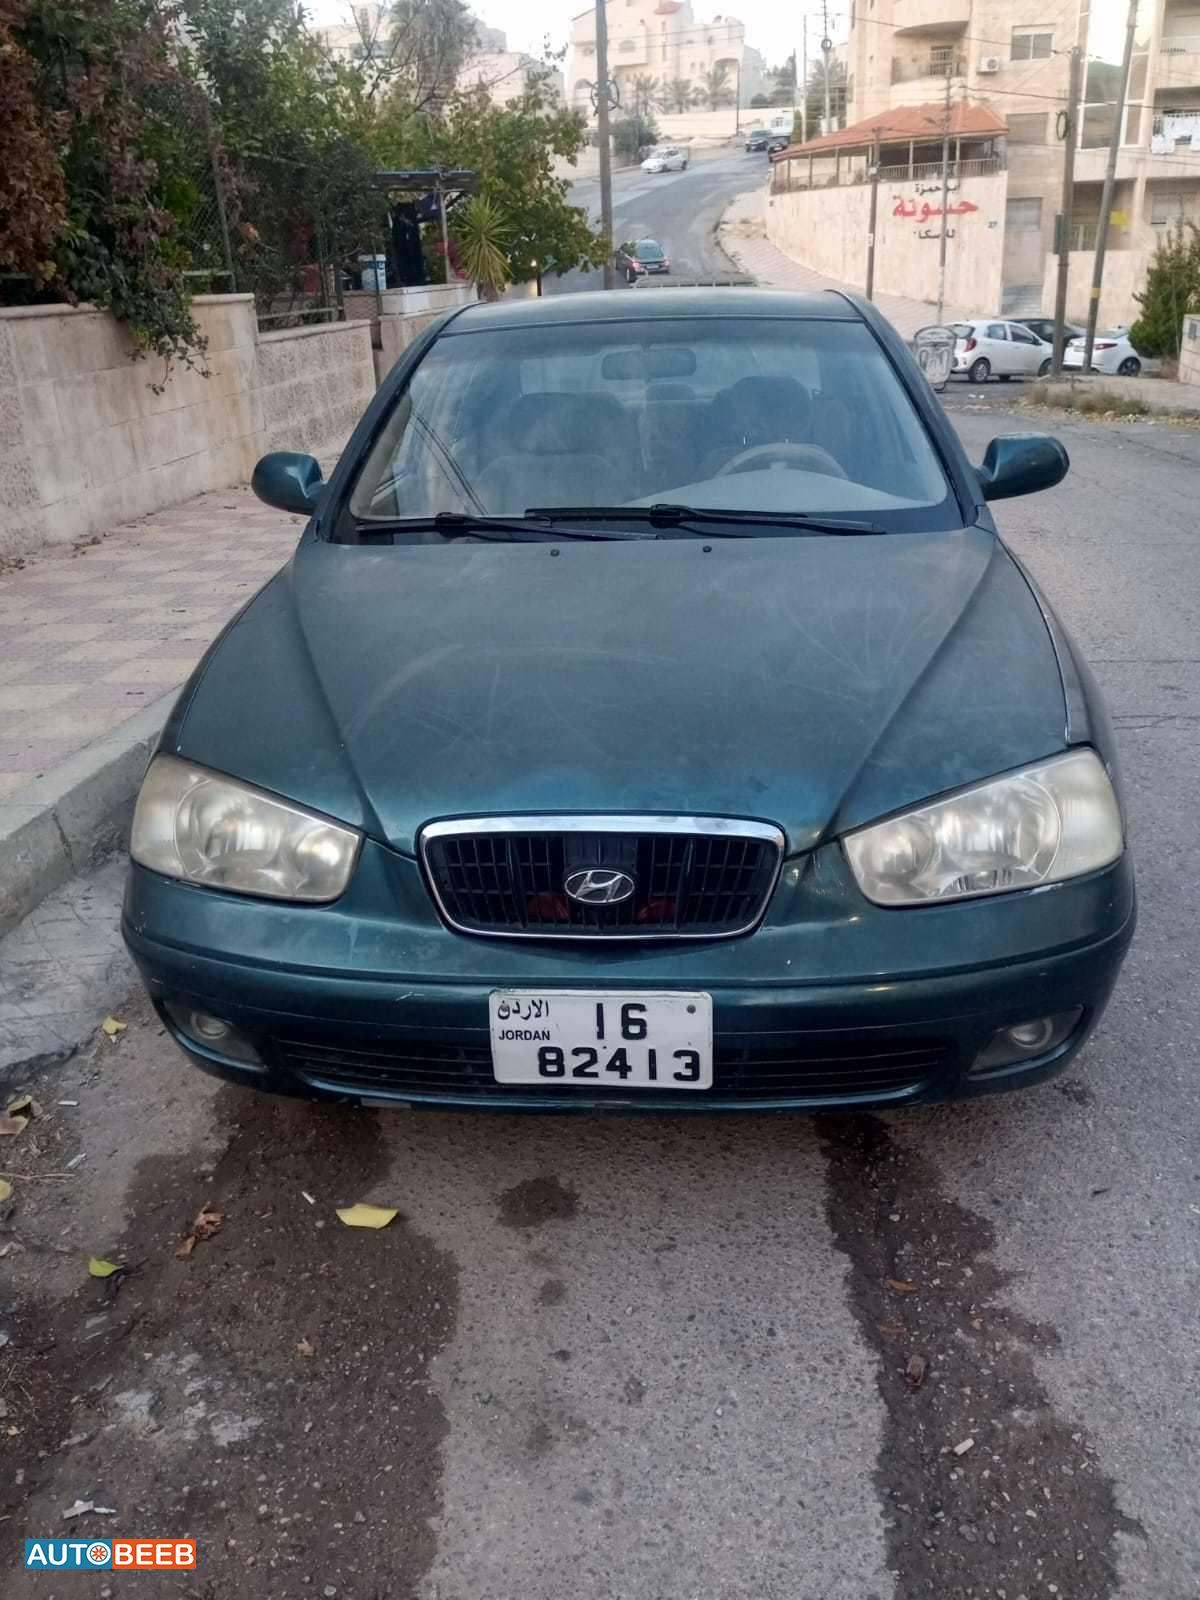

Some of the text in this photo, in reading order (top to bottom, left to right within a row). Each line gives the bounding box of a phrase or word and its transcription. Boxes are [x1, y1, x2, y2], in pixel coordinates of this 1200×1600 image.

[892, 195, 979, 223] حسونة
[497, 1000, 550, 1020] الاردن
[596, 1003, 648, 1041] 16
[498, 1030, 551, 1041] JORDAN
[537, 1046, 701, 1082] 82413
